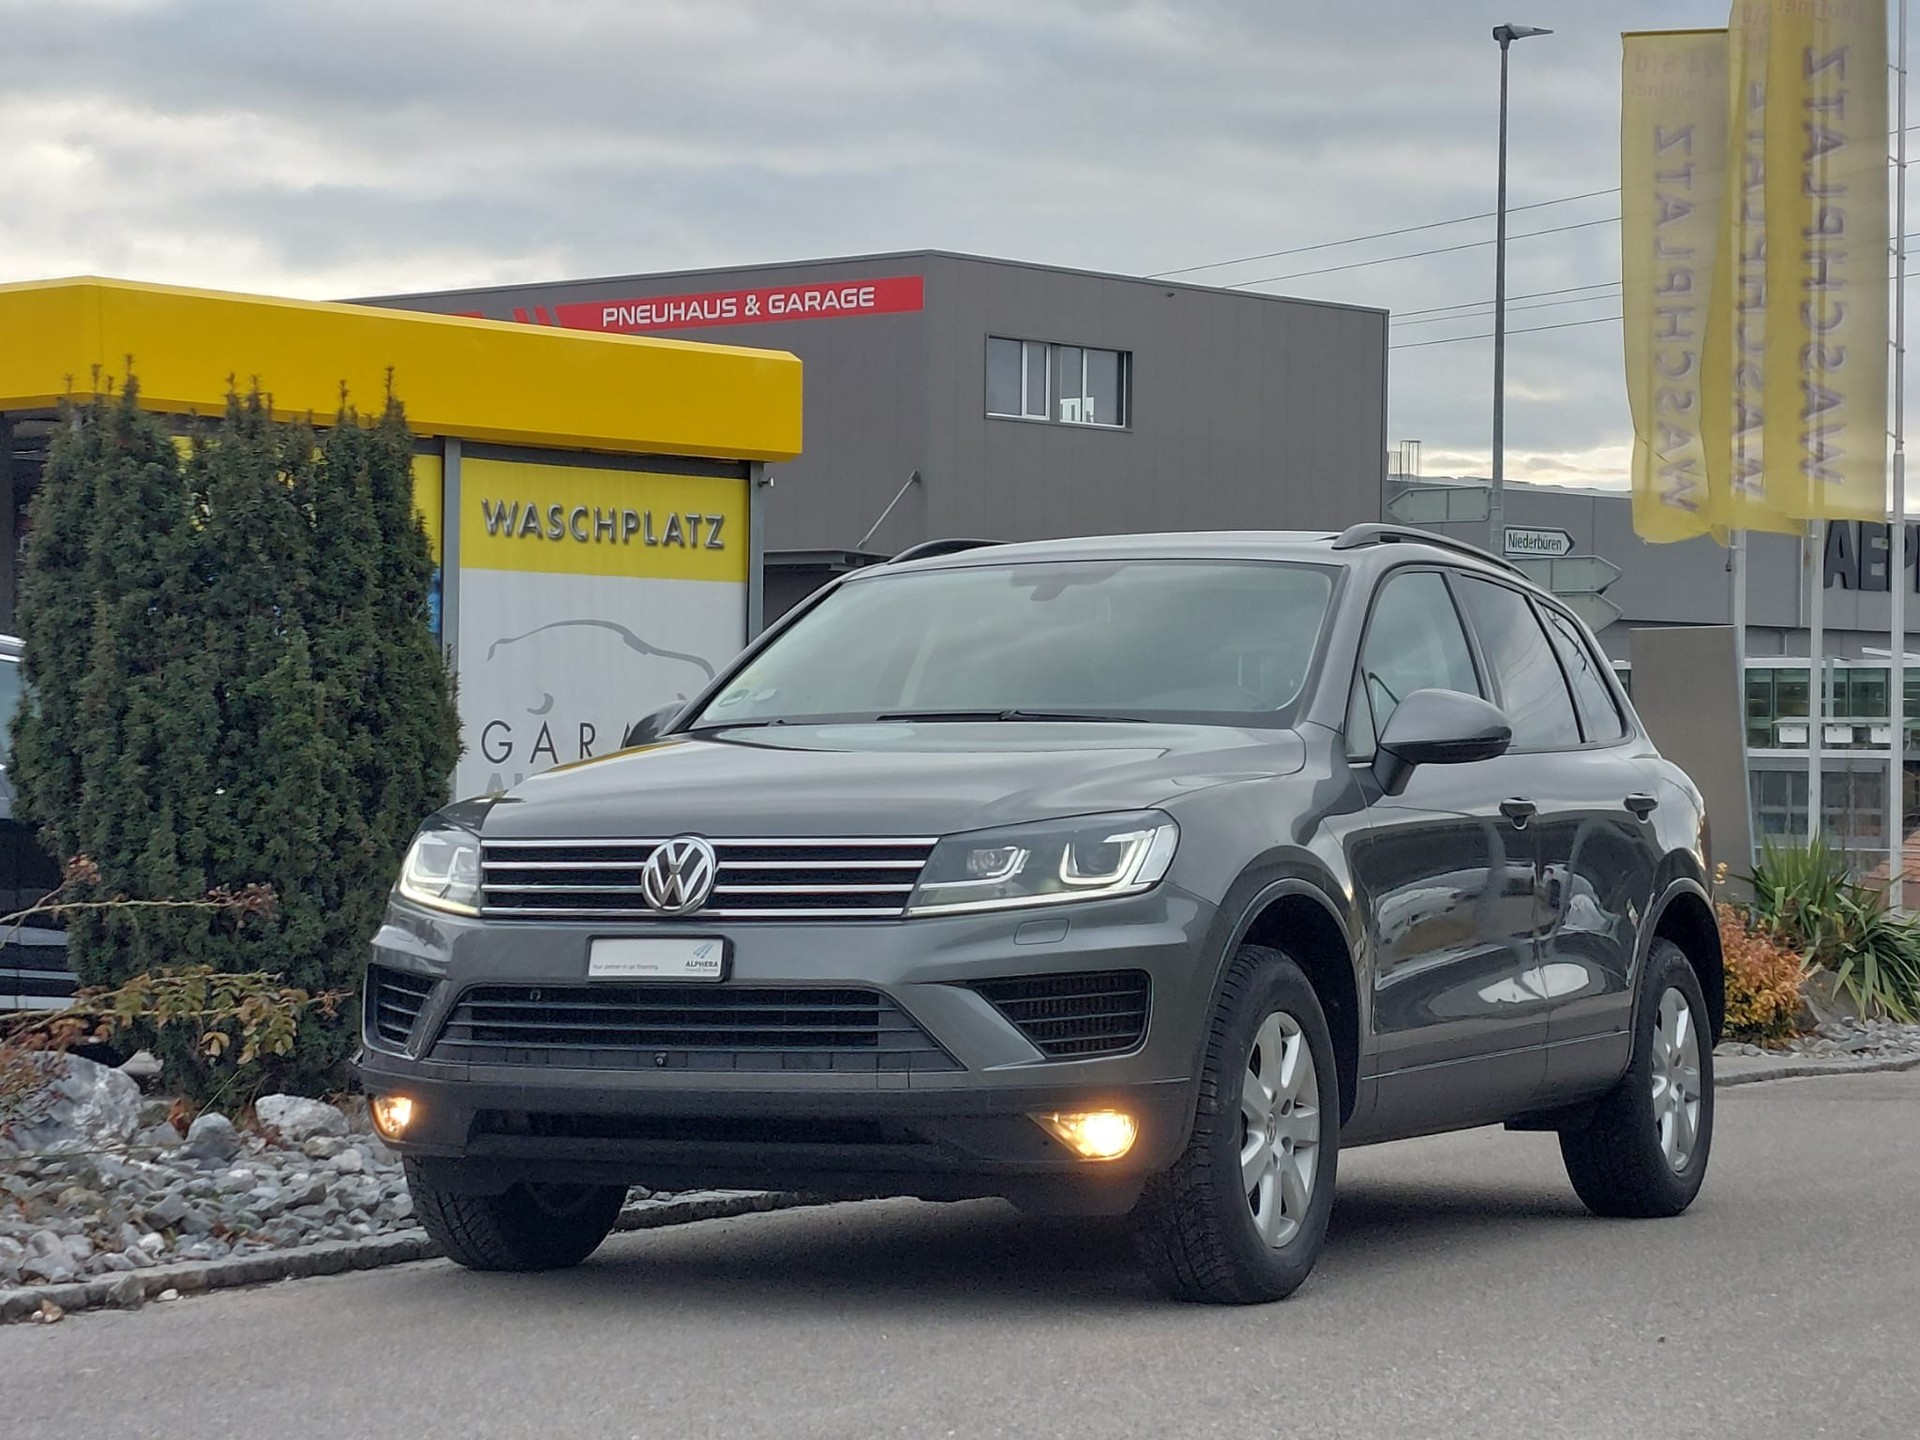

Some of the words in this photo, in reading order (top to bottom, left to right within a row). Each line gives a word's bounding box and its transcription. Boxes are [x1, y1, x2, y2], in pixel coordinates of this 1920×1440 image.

[602, 297, 737, 327] PNEUHAUS
[744, 294, 761, 316] &
[768, 286, 876, 314] GARAGE
[481, 497, 726, 549] WASCHPLATZ
[1508, 532, 1562, 551] Niederbüren
